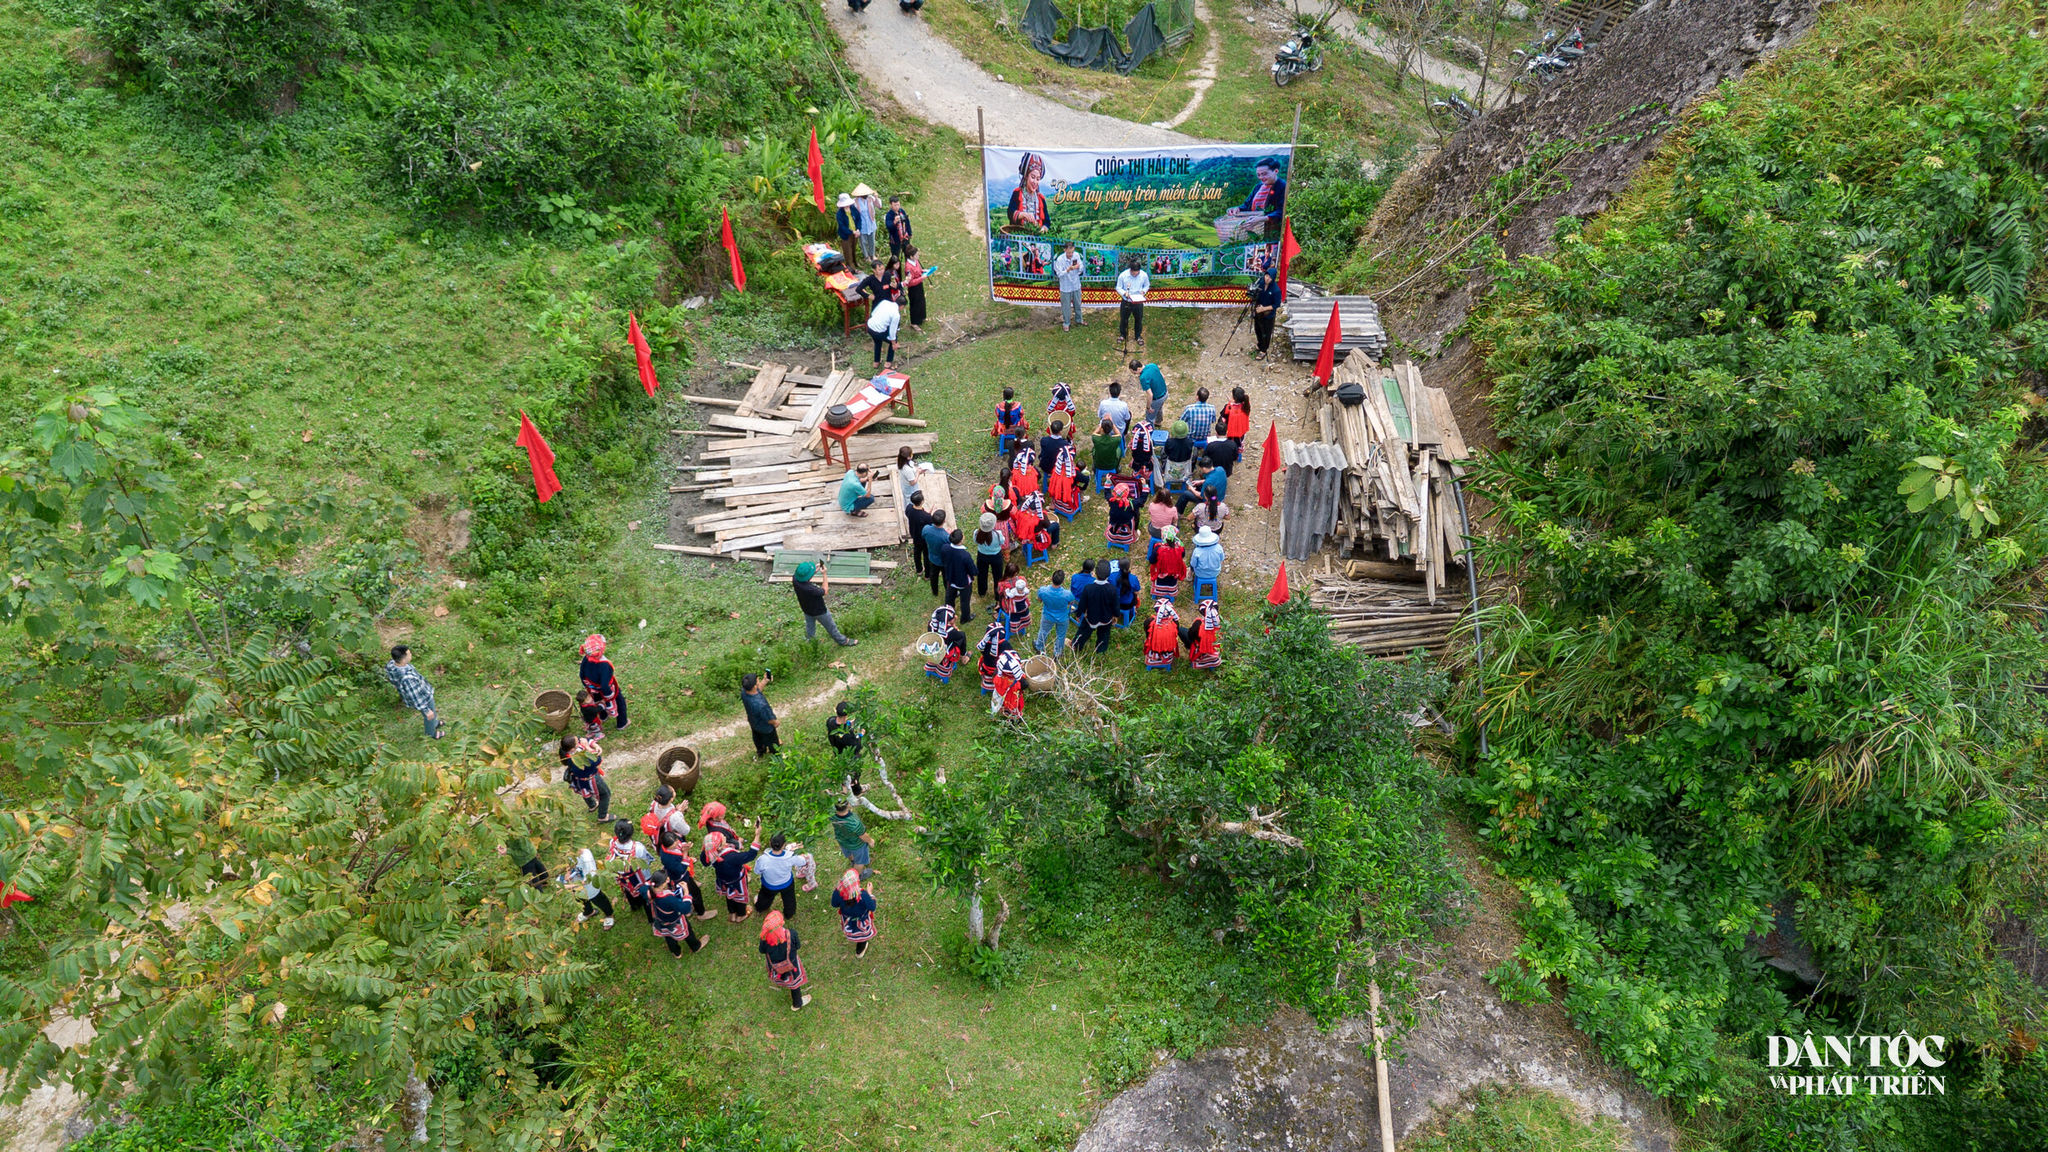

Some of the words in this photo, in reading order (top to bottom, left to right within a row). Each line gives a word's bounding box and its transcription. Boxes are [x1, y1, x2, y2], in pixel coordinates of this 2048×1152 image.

[1095, 155, 1125, 178] CUỘC
[1127, 158, 1145, 176] THI
[1147, 154, 1166, 175] HÁI
[1169, 154, 1191, 175] CHÈ
[1083, 186, 1104, 211] tay
[1105, 185, 1134, 210] vàng
[1134, 184, 1157, 202] trên
[1158, 182, 1186, 201] miền
